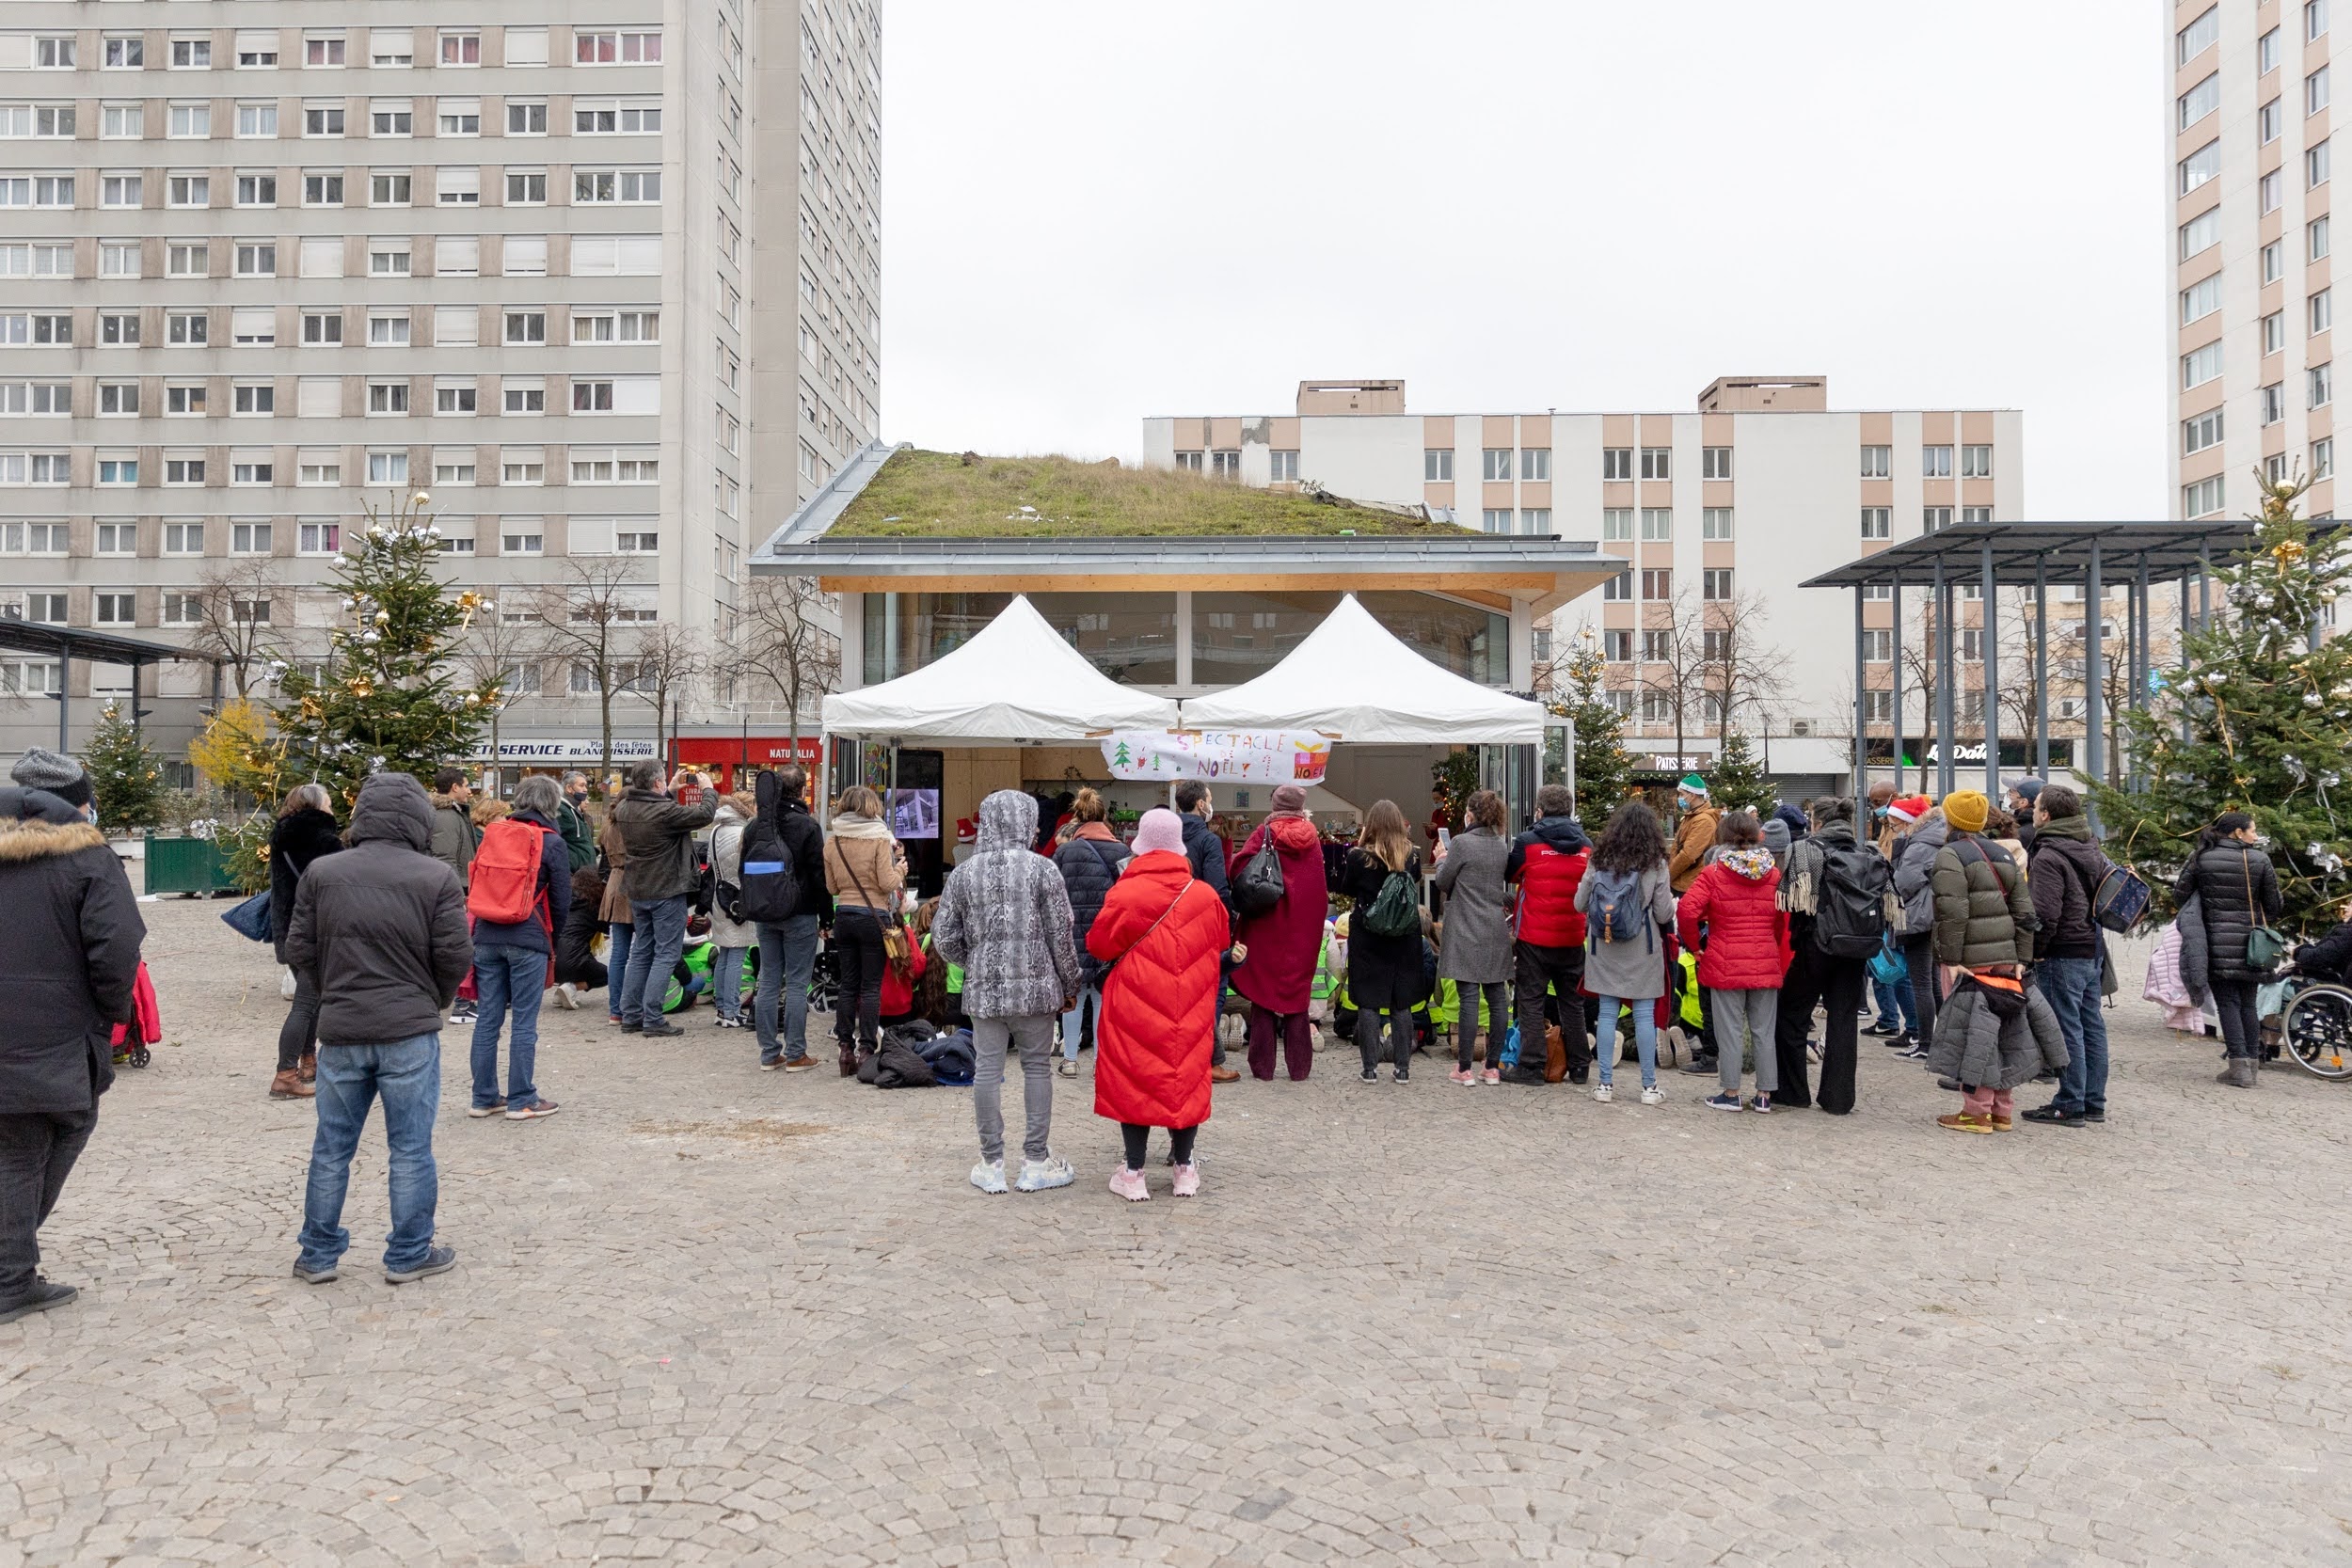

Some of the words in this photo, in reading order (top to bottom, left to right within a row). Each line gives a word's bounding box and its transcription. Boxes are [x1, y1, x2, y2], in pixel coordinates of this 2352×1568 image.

[1177, 733, 1287, 752] SPECTACLE
[498, 744, 564, 755] SERVICE
[770, 749, 815, 759] NATUALIA
[2049, 756, 2070, 767] CAFÉ
